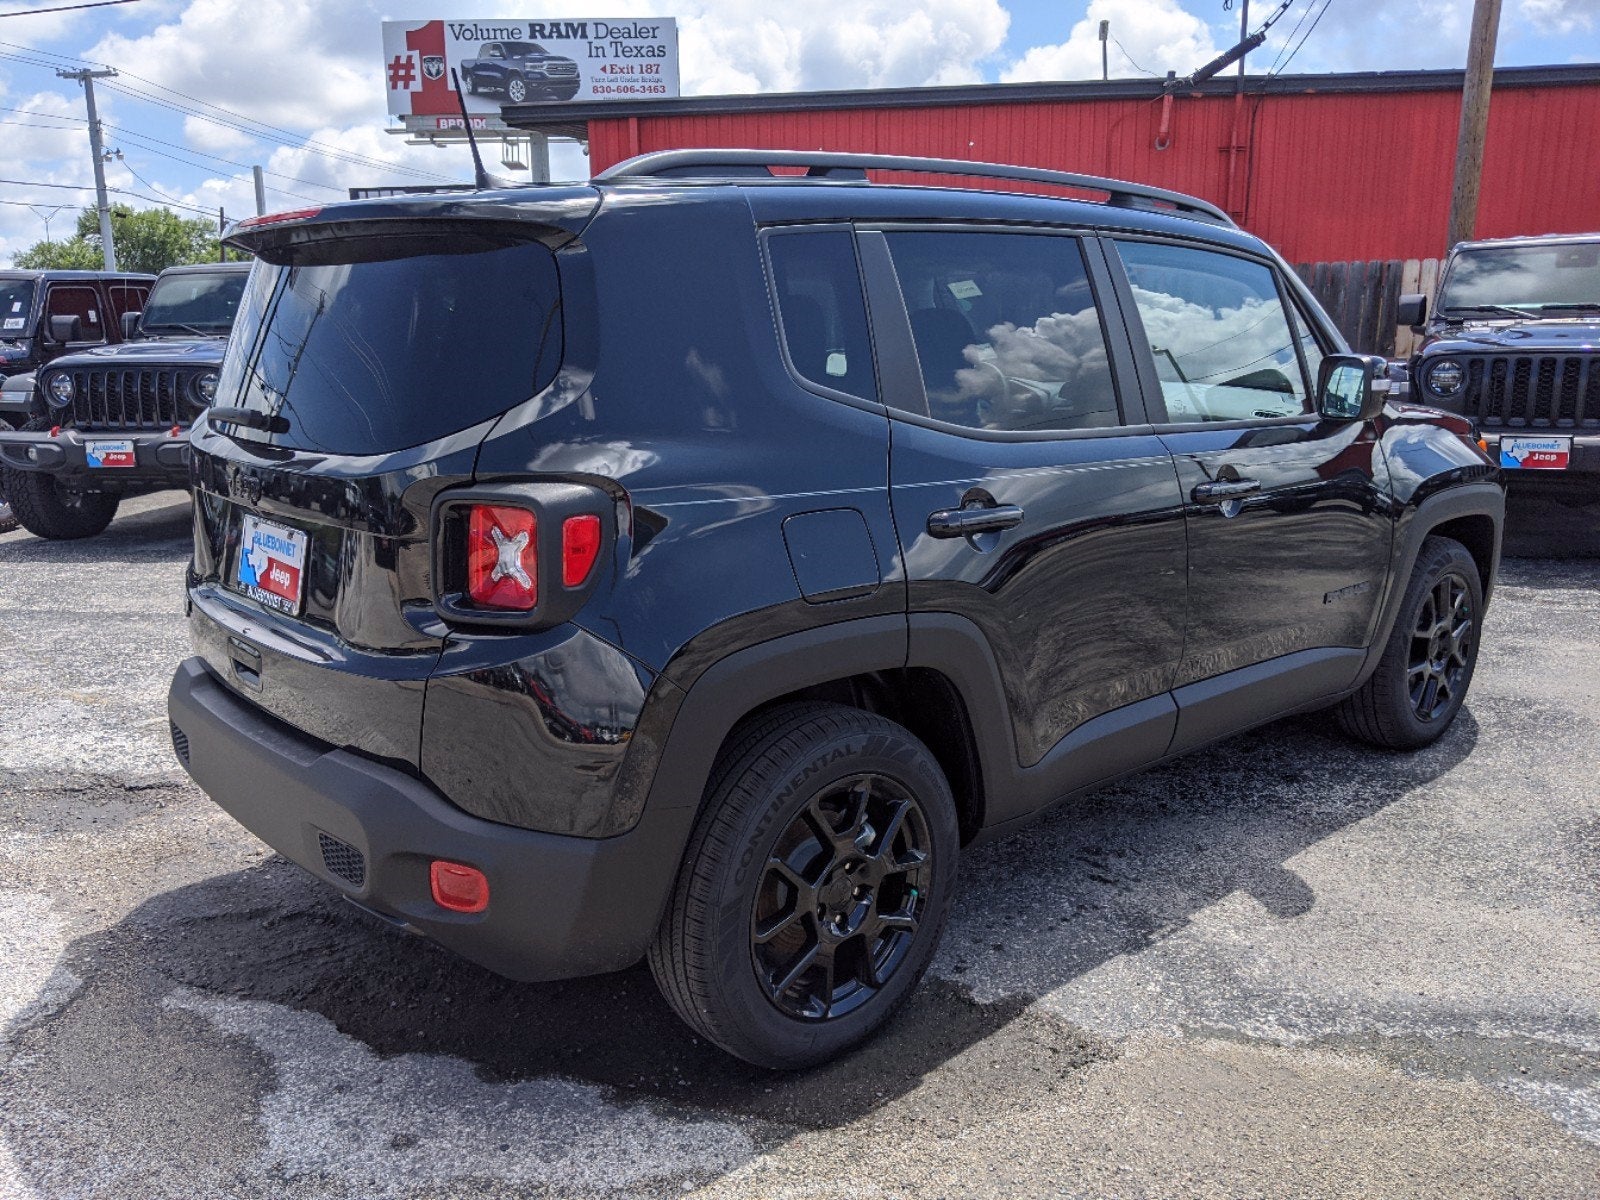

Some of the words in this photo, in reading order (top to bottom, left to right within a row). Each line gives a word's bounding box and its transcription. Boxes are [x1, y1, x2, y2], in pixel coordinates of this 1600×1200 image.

[449, 23, 522, 41] Volume
[528, 22, 588, 40] RAM
[593, 22, 660, 39] Dealer
[587, 41, 607, 58] In
[609, 41, 666, 58] Texas
[609, 63, 635, 75] Exit
[638, 63, 660, 75] 187
[592, 85, 667, 94] 830-606-3463
[1533, 453, 1557, 461] Jeep
[253, 530, 297, 558] BLUEBONNET
[269, 562, 290, 590] Jeep
